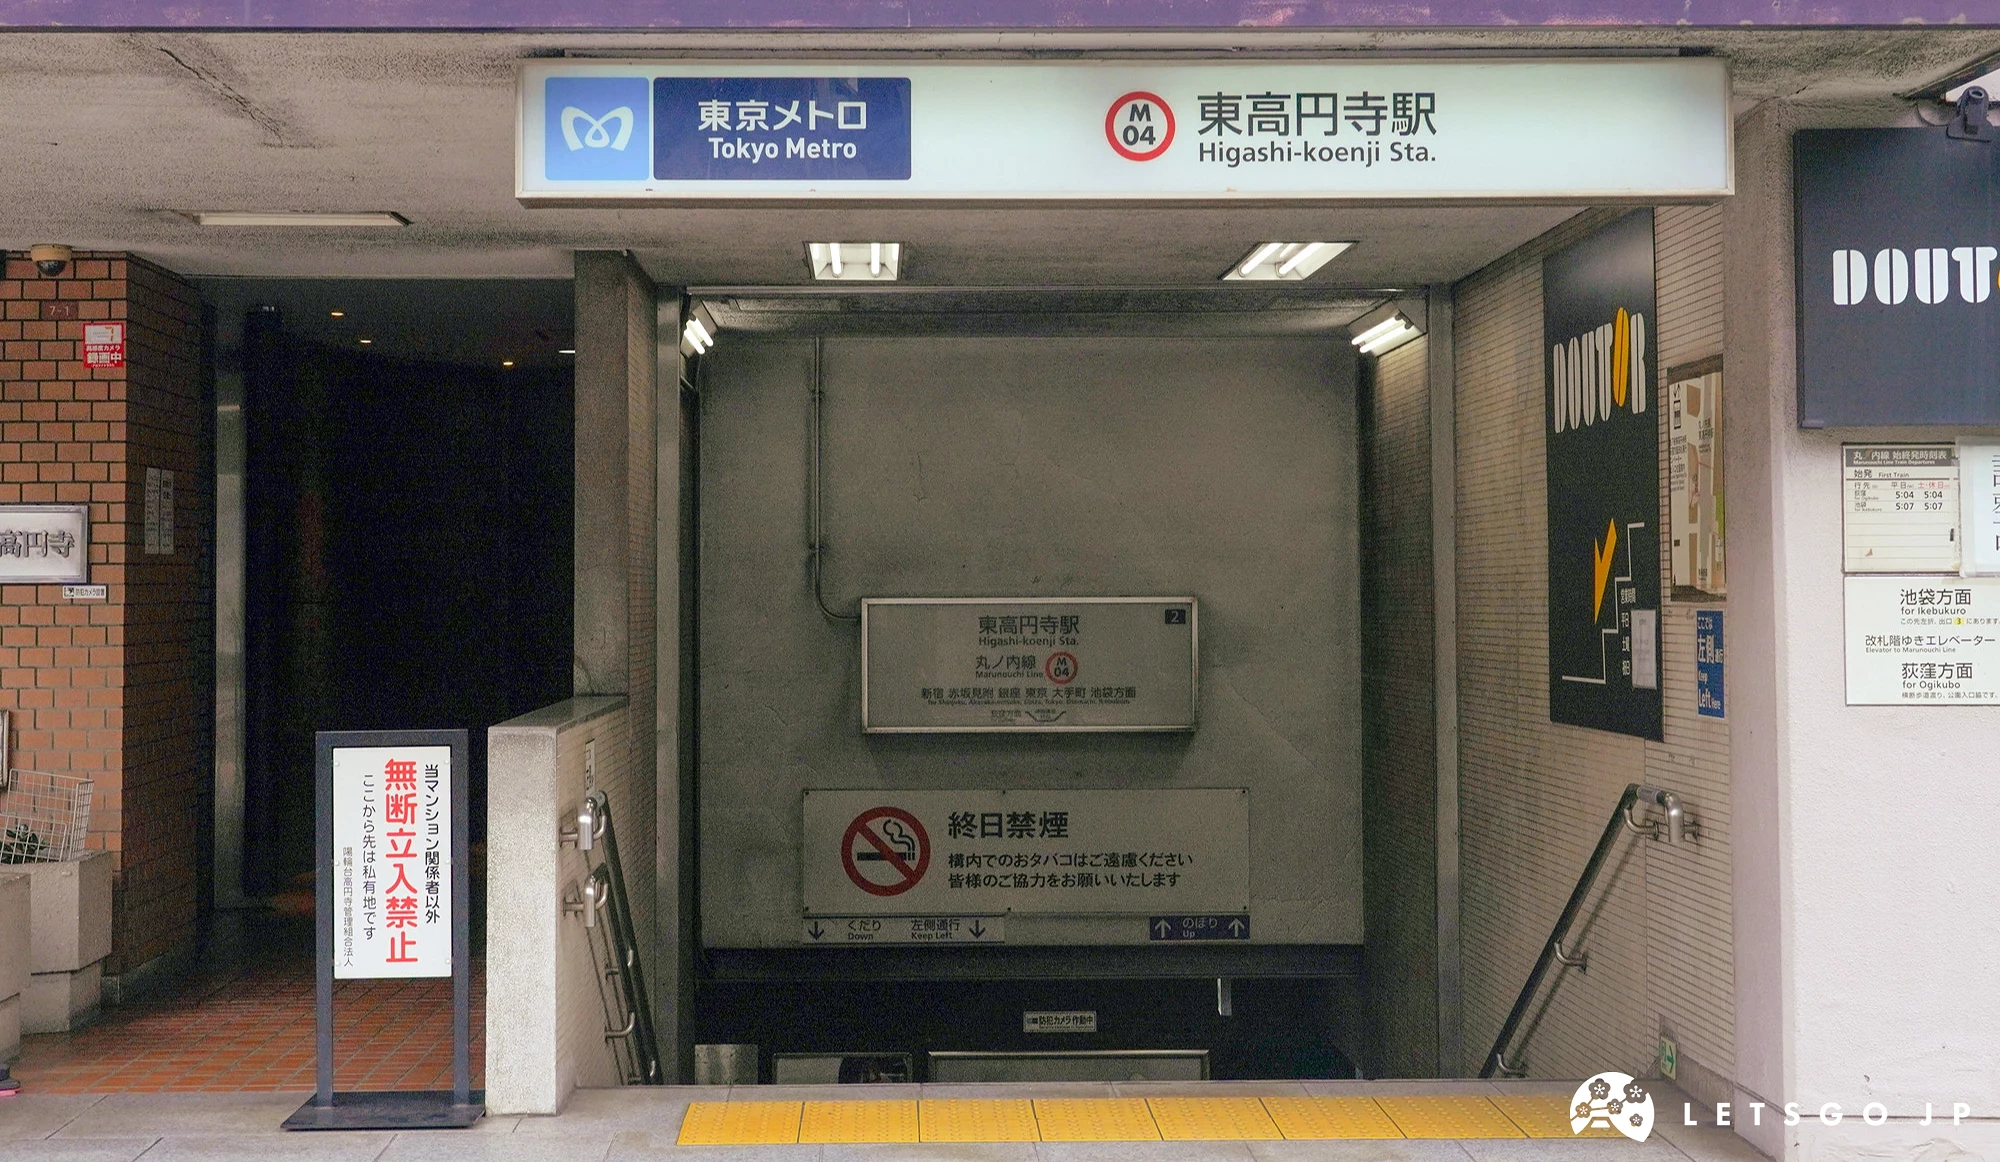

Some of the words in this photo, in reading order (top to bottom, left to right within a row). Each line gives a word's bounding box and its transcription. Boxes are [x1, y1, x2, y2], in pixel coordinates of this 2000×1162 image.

[698, 99, 867, 132] 東京メトロ
[1129, 103, 1152, 122] M
[1197, 91, 1437, 137] 東高円寺駅
[1122, 125, 1156, 146] 04
[709, 137, 779, 164] Tokyo
[786, 137, 857, 160] Metro
[1199, 141, 1381, 168] Higashi-koenji
[1390, 141, 1437, 163] Sta.
[1832, 246, 2000, 306] DOUT
[49, 304, 70, 317] 7-1
[1553, 307, 1647, 434] DOUTOR
[1892, 450, 1947, 460] 始終発時刻表
[1854, 469, 1873, 479] 始発
[1895, 490, 1914, 499] 5:04
[1924, 490, 1943, 499] 5:04
[1895, 502, 1914, 511] 5:07
[1924, 502, 1943, 511] 5:07
[1900, 588, 1972, 606] 池袋方面
[1171, 610, 1180, 623] 2
[1901, 606, 1915, 615] for
[1917, 606, 1967, 615] Ikebukuro
[978, 614, 1080, 635] 東高円寺駅
[978, 636, 1056, 649] Higashi-koenji
[1060, 636, 1080, 646] Sta.
[1865, 635, 1996, 647] 改札階ゆきエレベーター
[975, 654, 1037, 670] 丸ノ内線
[1056, 657, 1067, 667] M
[975, 670, 1024, 679] Marunouchi
[1053, 667, 1070, 678] 04
[1902, 662, 1973, 679] 荻窪方面
[1902, 680, 1916, 689] for
[1919, 680, 1961, 691] Ogikubo
[1025, 686, 1048, 700] 東京
[1052, 686, 1086, 700] 大手町
[1090, 686, 1137, 700] 池袋方面
[948, 811, 1069, 839] 終日禁煙
[424, 764, 441, 924] 当マンション関係者以外
[362, 774, 377, 940] ここから先は私有地です
[384, 758, 419, 964] 無断立入禁止
[948, 852, 1193, 868] 構内でのおタバコはご遠慮ください
[948, 872, 1182, 889] 皆様のご協力をお願いいたします
[847, 919, 882, 931] くだり
[911, 918, 961, 931] 左側通行
[1182, 917, 1218, 929] のぼり
[848, 932, 874, 941] Down
[911, 932, 934, 942] Keep
[936, 931, 953, 940] Left
[1182, 930, 1196, 939] Up
